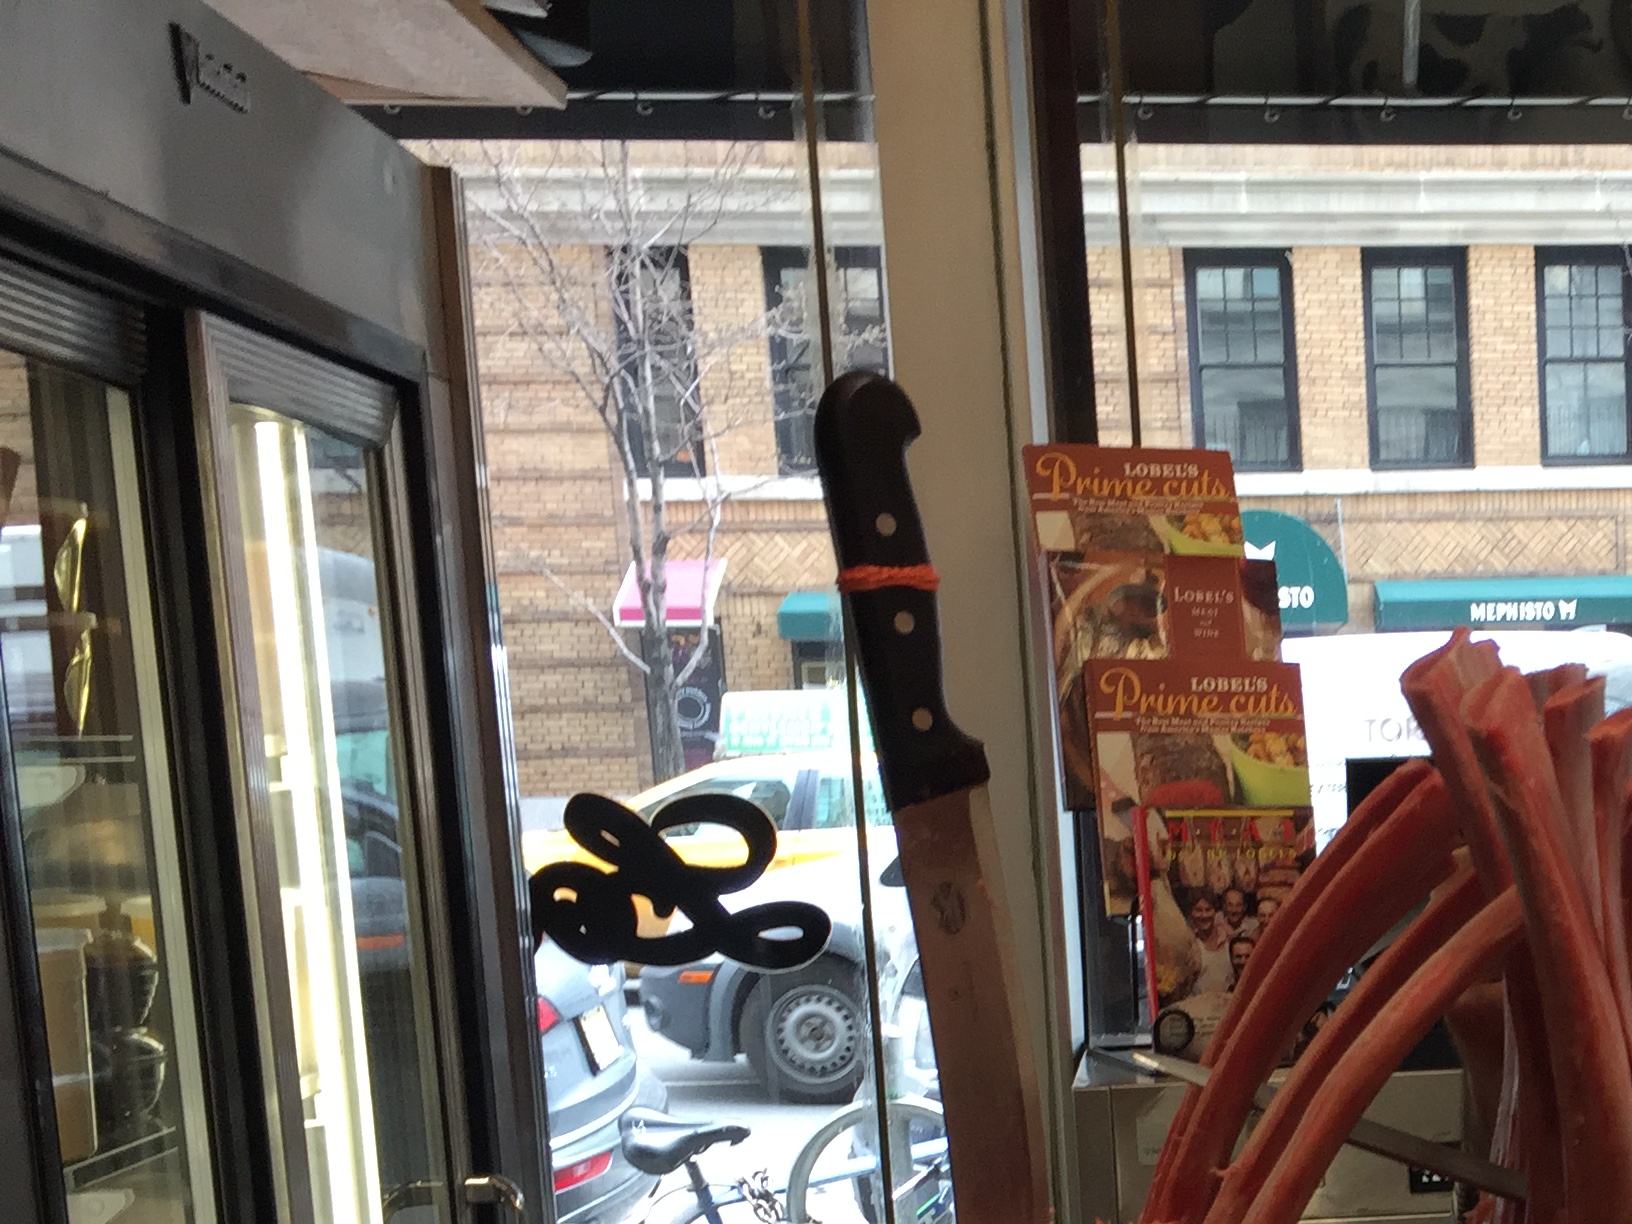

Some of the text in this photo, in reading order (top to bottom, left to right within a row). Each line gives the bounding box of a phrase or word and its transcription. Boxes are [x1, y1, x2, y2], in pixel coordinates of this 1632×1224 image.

[1035, 452, 1231, 501] Prime cuts
[1124, 462, 1199, 478] LOBEL'S
[1470, 601, 1555, 622] MEPHISTO
[1099, 667, 1298, 720] Prime cuts
[1190, 676, 1269, 693] LOBEL'S
